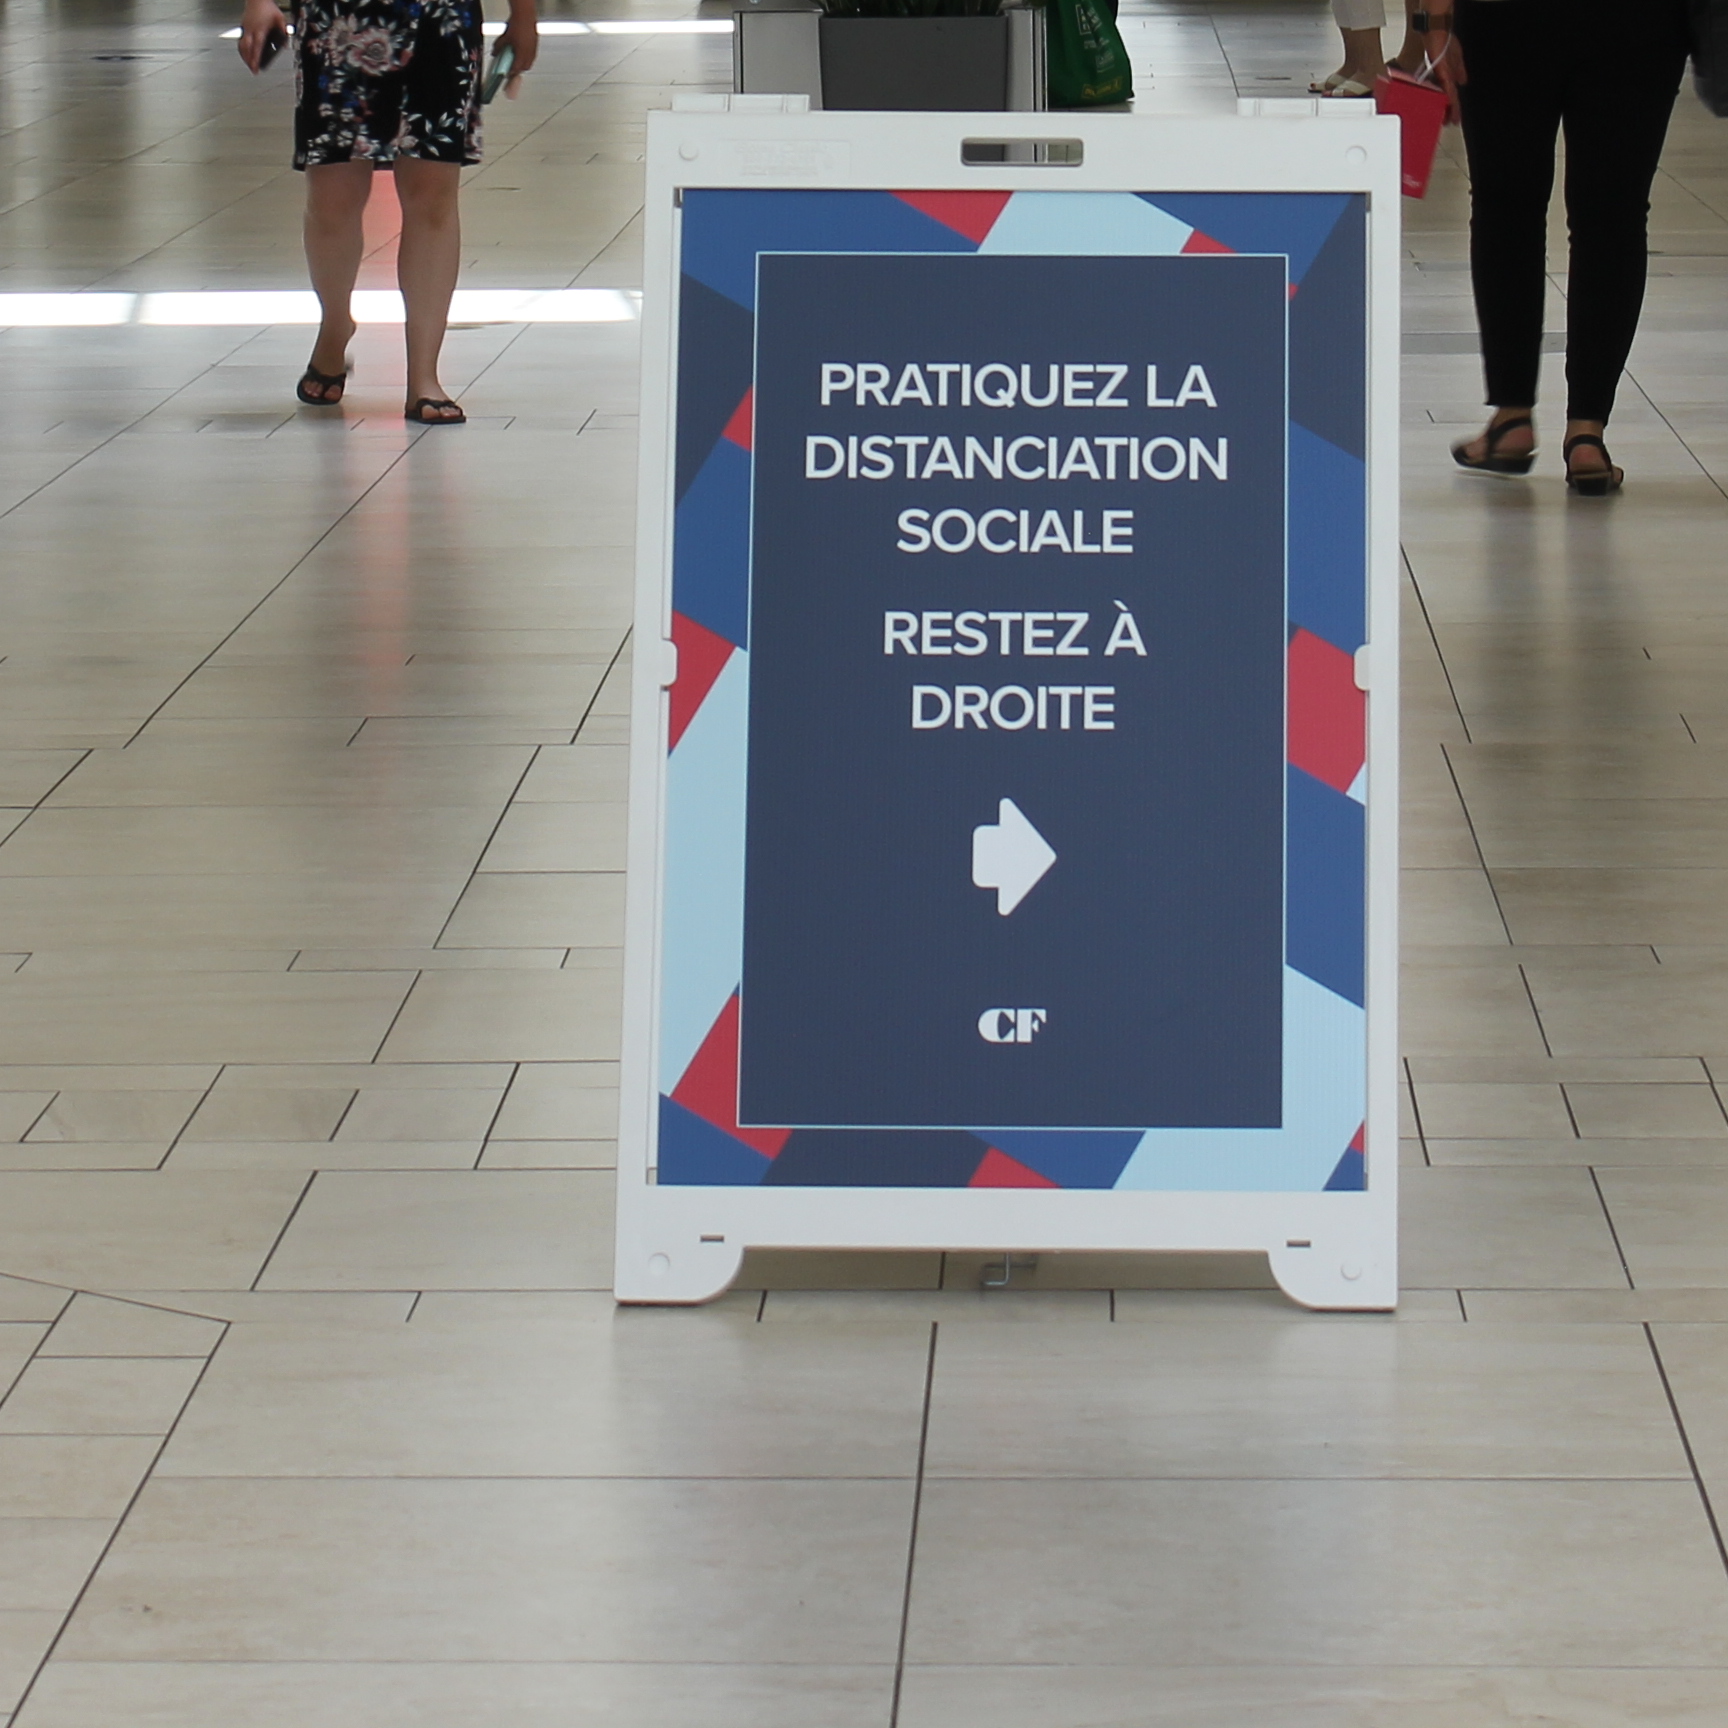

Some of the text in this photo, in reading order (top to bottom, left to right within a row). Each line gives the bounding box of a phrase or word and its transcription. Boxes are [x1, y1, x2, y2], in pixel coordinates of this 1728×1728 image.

[818, 362, 1218, 411] PRATIQUEZ LA
[803, 435, 1229, 482] DISTANCIATION
[895, 508, 1135, 555] SOCIALE
[882, 599, 1147, 657] RESTEZ À
[910, 685, 1116, 732] DROITE
[977, 1007, 1047, 1044] CF
